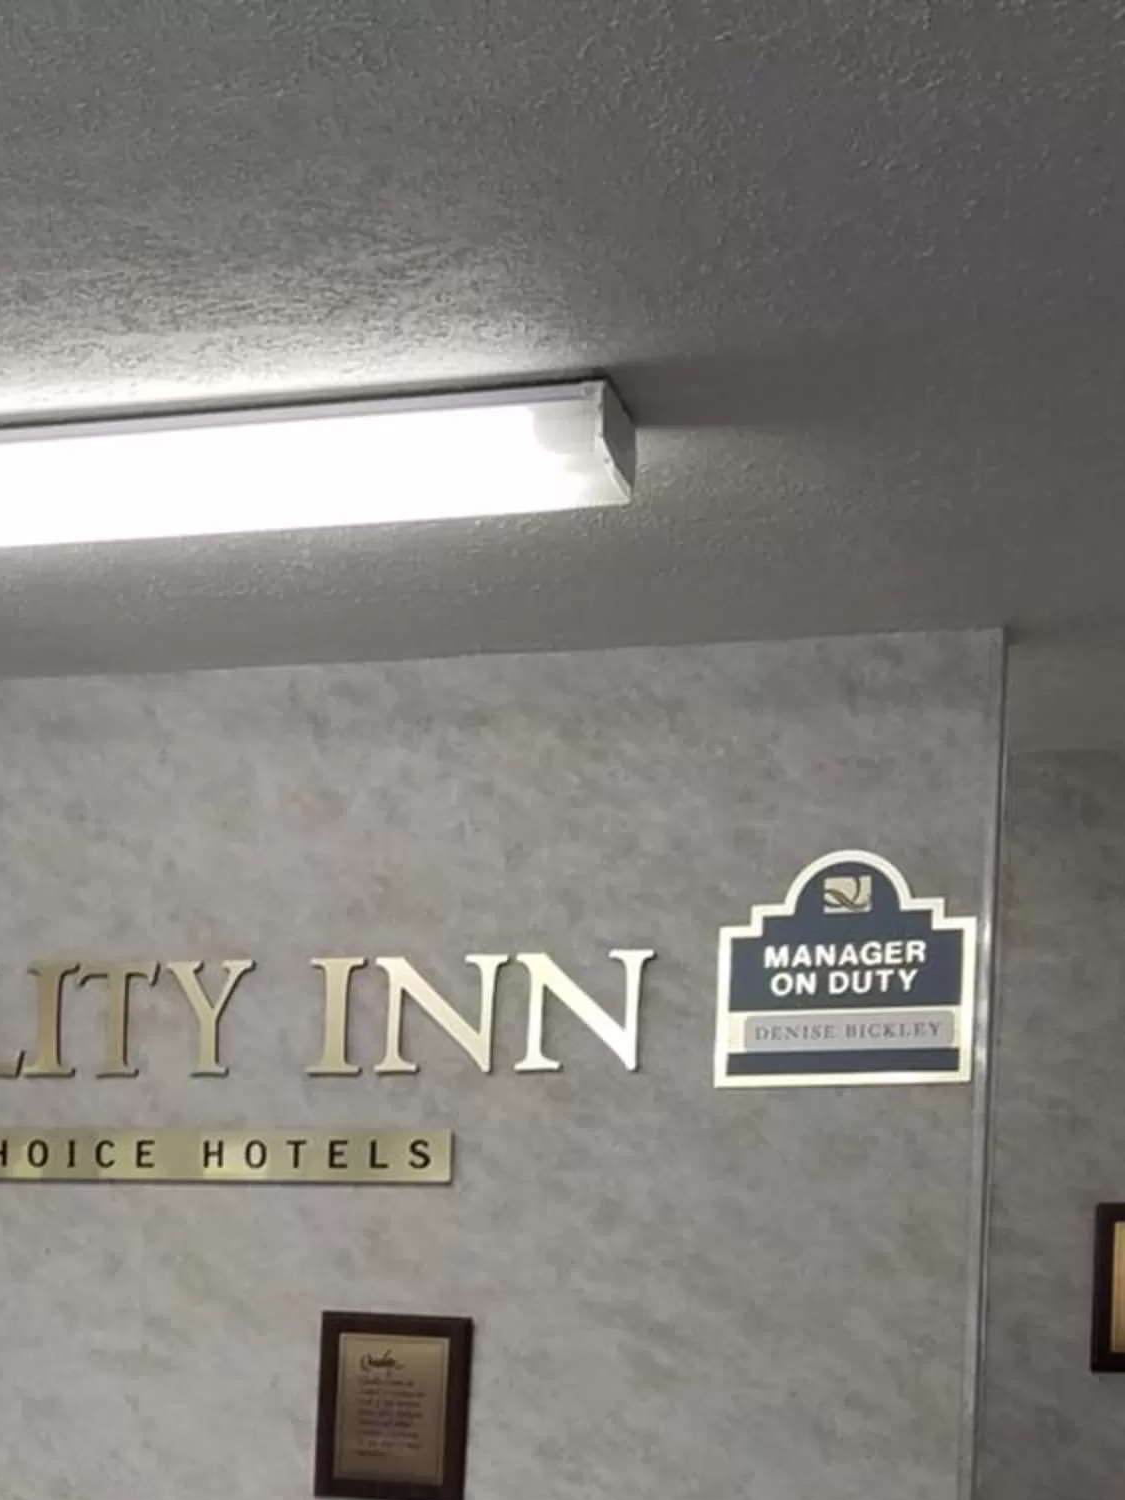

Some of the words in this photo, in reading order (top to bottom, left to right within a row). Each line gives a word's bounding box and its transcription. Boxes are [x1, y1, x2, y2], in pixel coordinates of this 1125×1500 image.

[763, 940, 927, 968] MANAGER
[770, 972, 816, 996] ON
[828, 969, 918, 995] DUTY
[306, 948, 655, 1077] INN
[754, 1023, 837, 1042] DENISE
[845, 1020, 943, 1040] BICKLEY
[202, 1138, 432, 1169] HOTELS
